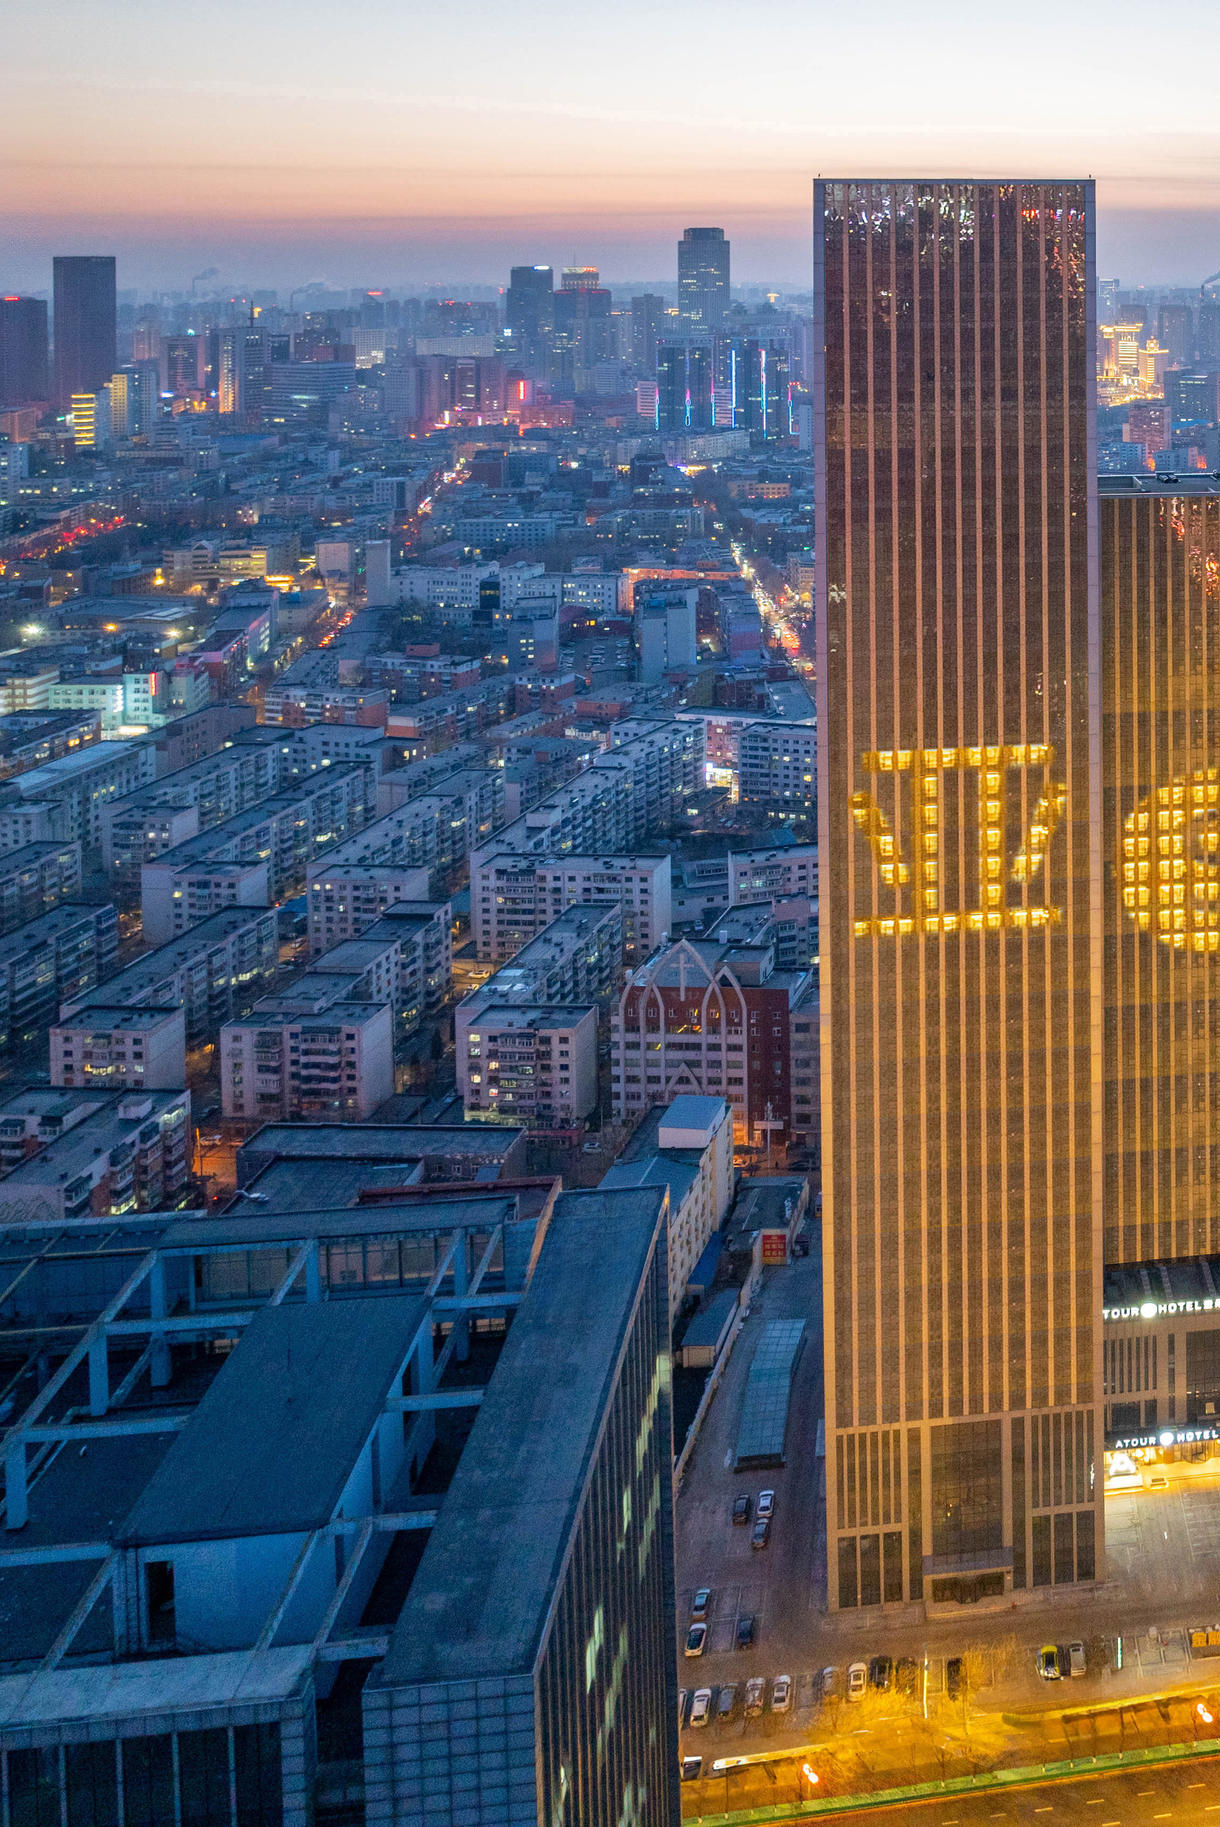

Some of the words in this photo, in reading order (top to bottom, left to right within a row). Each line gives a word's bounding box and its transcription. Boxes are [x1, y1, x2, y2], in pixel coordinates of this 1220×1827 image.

[849, 744, 1067, 937] 亚
[1158, 1300, 1202, 1314] HOTEL
[1115, 1436, 1157, 1448] ATOUR
[1176, 1430, 1219, 1443] HOTEL
